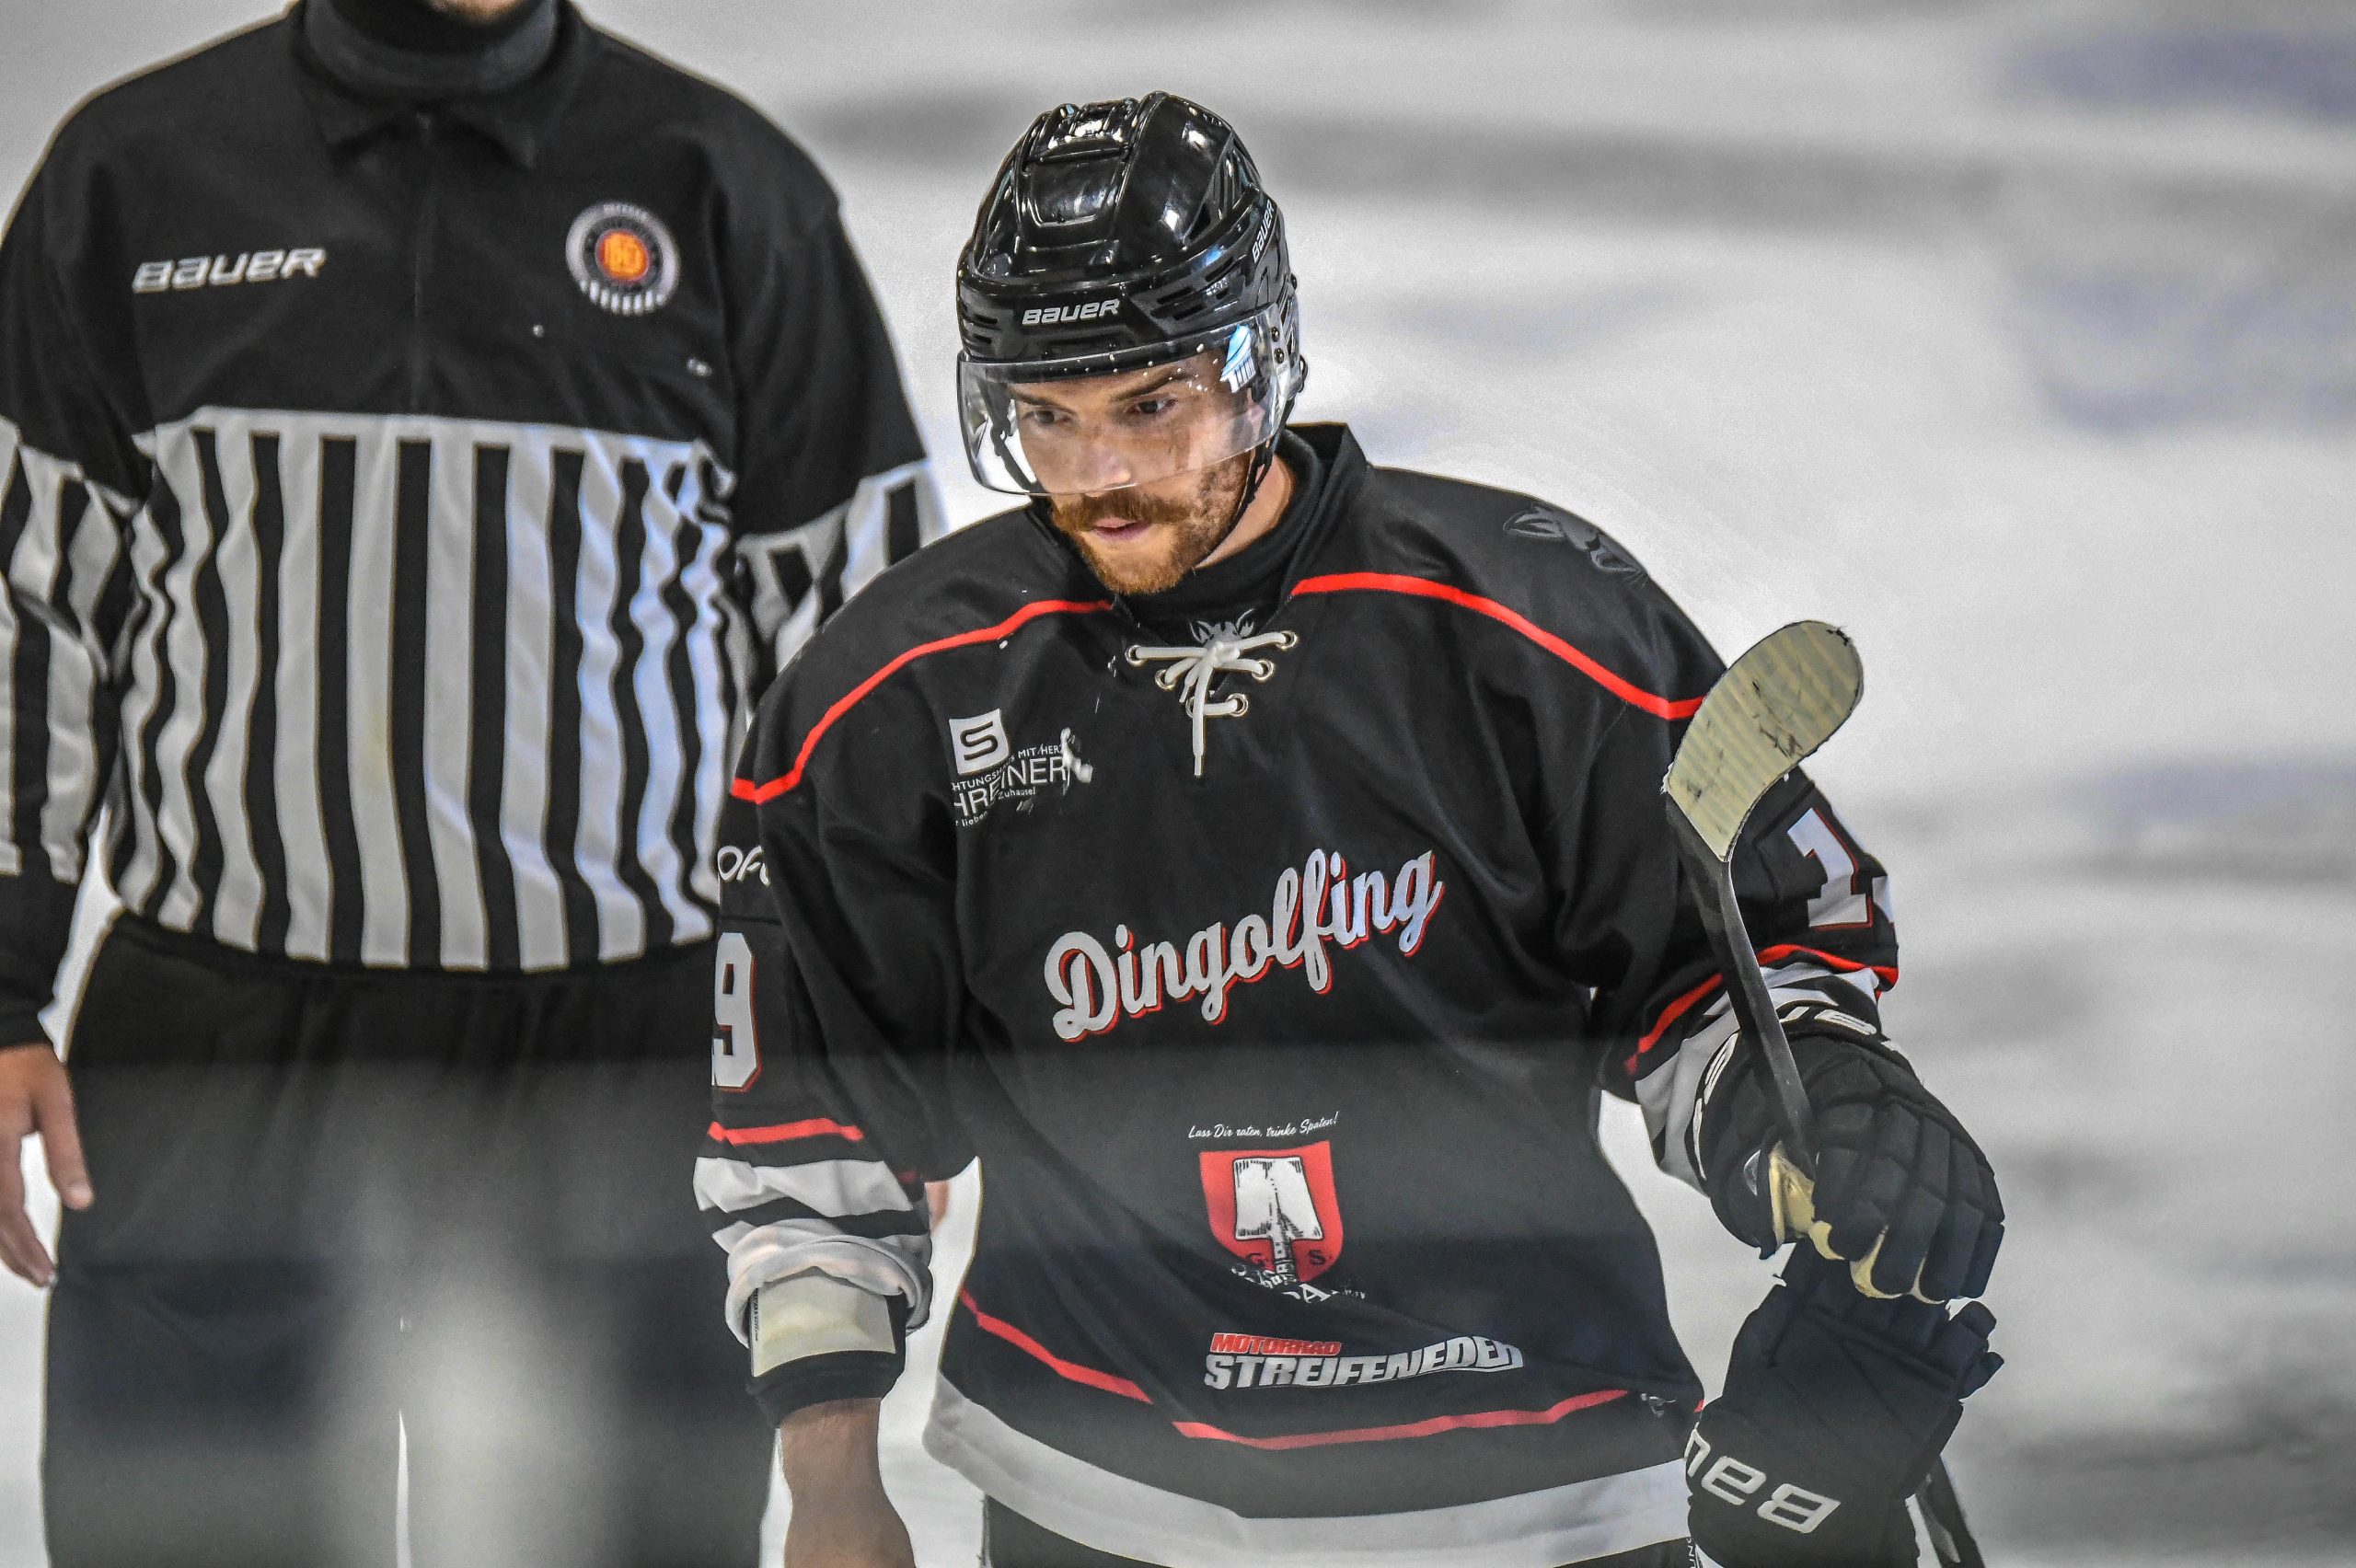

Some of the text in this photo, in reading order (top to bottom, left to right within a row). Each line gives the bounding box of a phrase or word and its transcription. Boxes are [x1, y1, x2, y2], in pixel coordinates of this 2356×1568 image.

[1253, 199, 1274, 263] BAUER
[133, 248, 327, 293] BAUER
[1022, 298, 1121, 326] BAUER
[1018, 746, 1037, 758] MIT
[1039, 744, 1063, 755] HER
[1044, 848, 1445, 1042] Dingolfing
[1188, 1124, 1211, 1138] Lass
[1213, 1124, 1233, 1138] Dir
[1265, 1122, 1297, 1137] trinke
[1299, 1111, 1339, 1135] Spaten!
[1210, 1332, 1342, 1355] MOTORRAD
